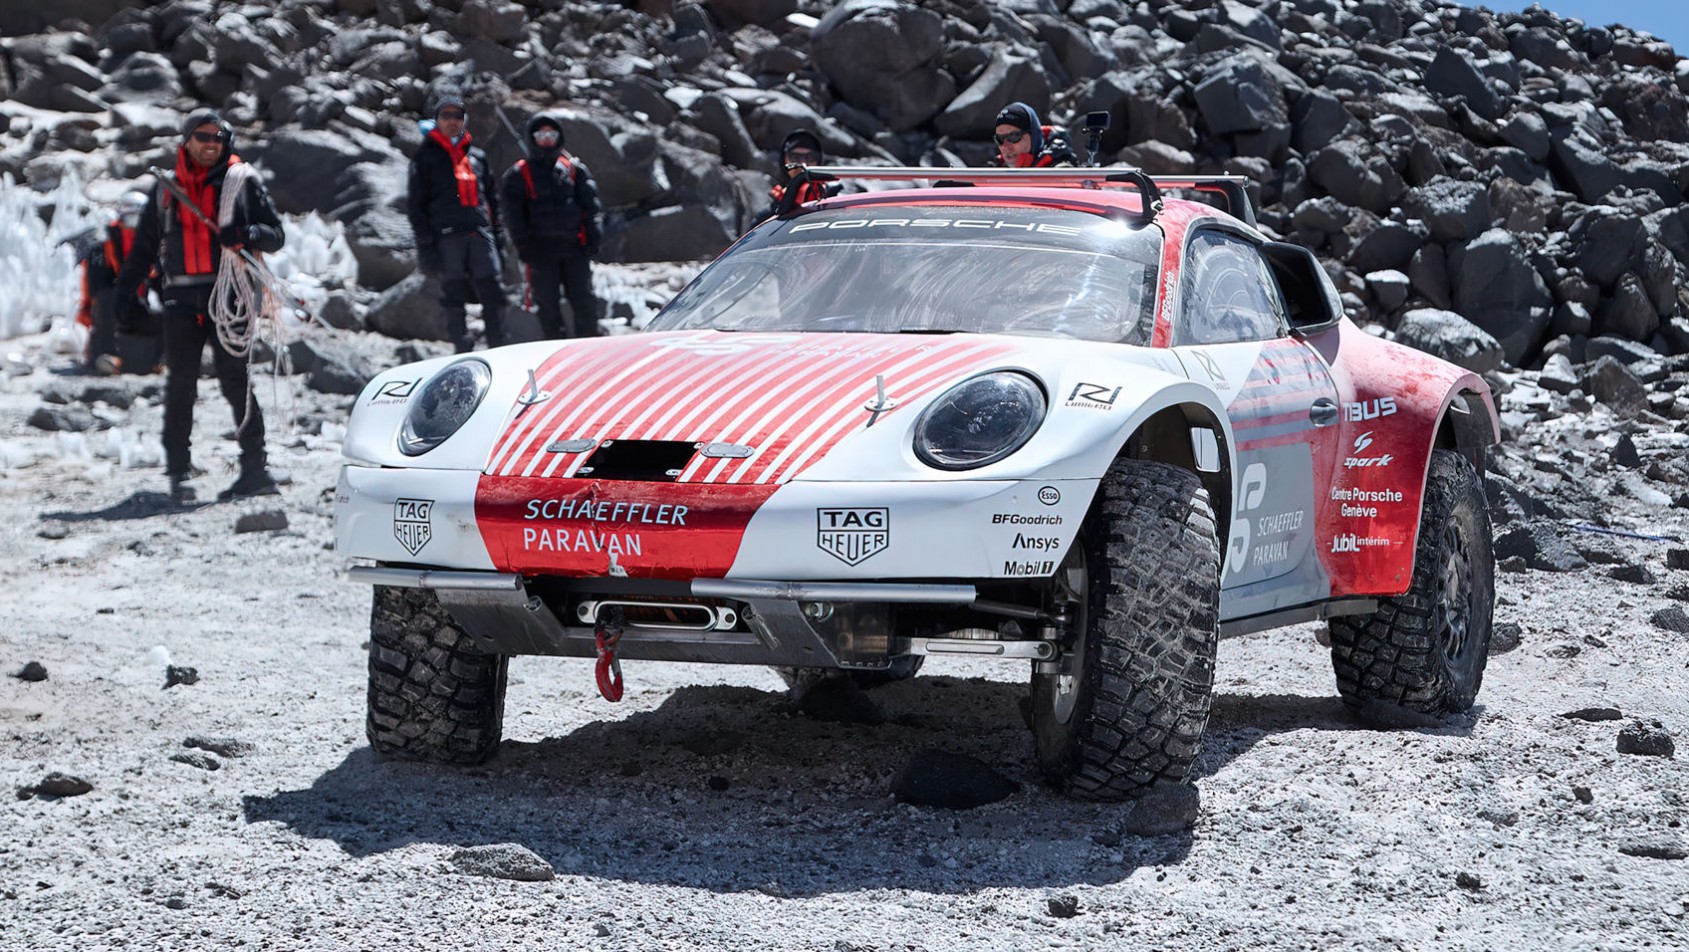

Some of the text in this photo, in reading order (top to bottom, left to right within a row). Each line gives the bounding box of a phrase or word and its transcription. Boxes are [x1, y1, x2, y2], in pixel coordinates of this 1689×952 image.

[789, 218, 1081, 236] PORSCHE
[1344, 454, 1394, 469] spark
[1041, 489, 1058, 501] Esso
[1331, 486, 1403, 502] Centre Porsche
[397, 500, 428, 520] TAG
[524, 498, 688, 526] SCHAEFFLER
[823, 511, 883, 528] TAG
[992, 512, 1063, 526] BFGoodrich
[1341, 502, 1377, 518] Genève
[1257, 510, 1304, 537] SCHAEFFLER
[396, 523, 431, 552] HEUER
[523, 527, 642, 557] PARAVAN
[822, 533, 885, 560] HEUER
[1011, 532, 1060, 552] Ansys
[1253, 541, 1288, 566] PARAVAN
[1003, 560, 1055, 576] Mobil 1
